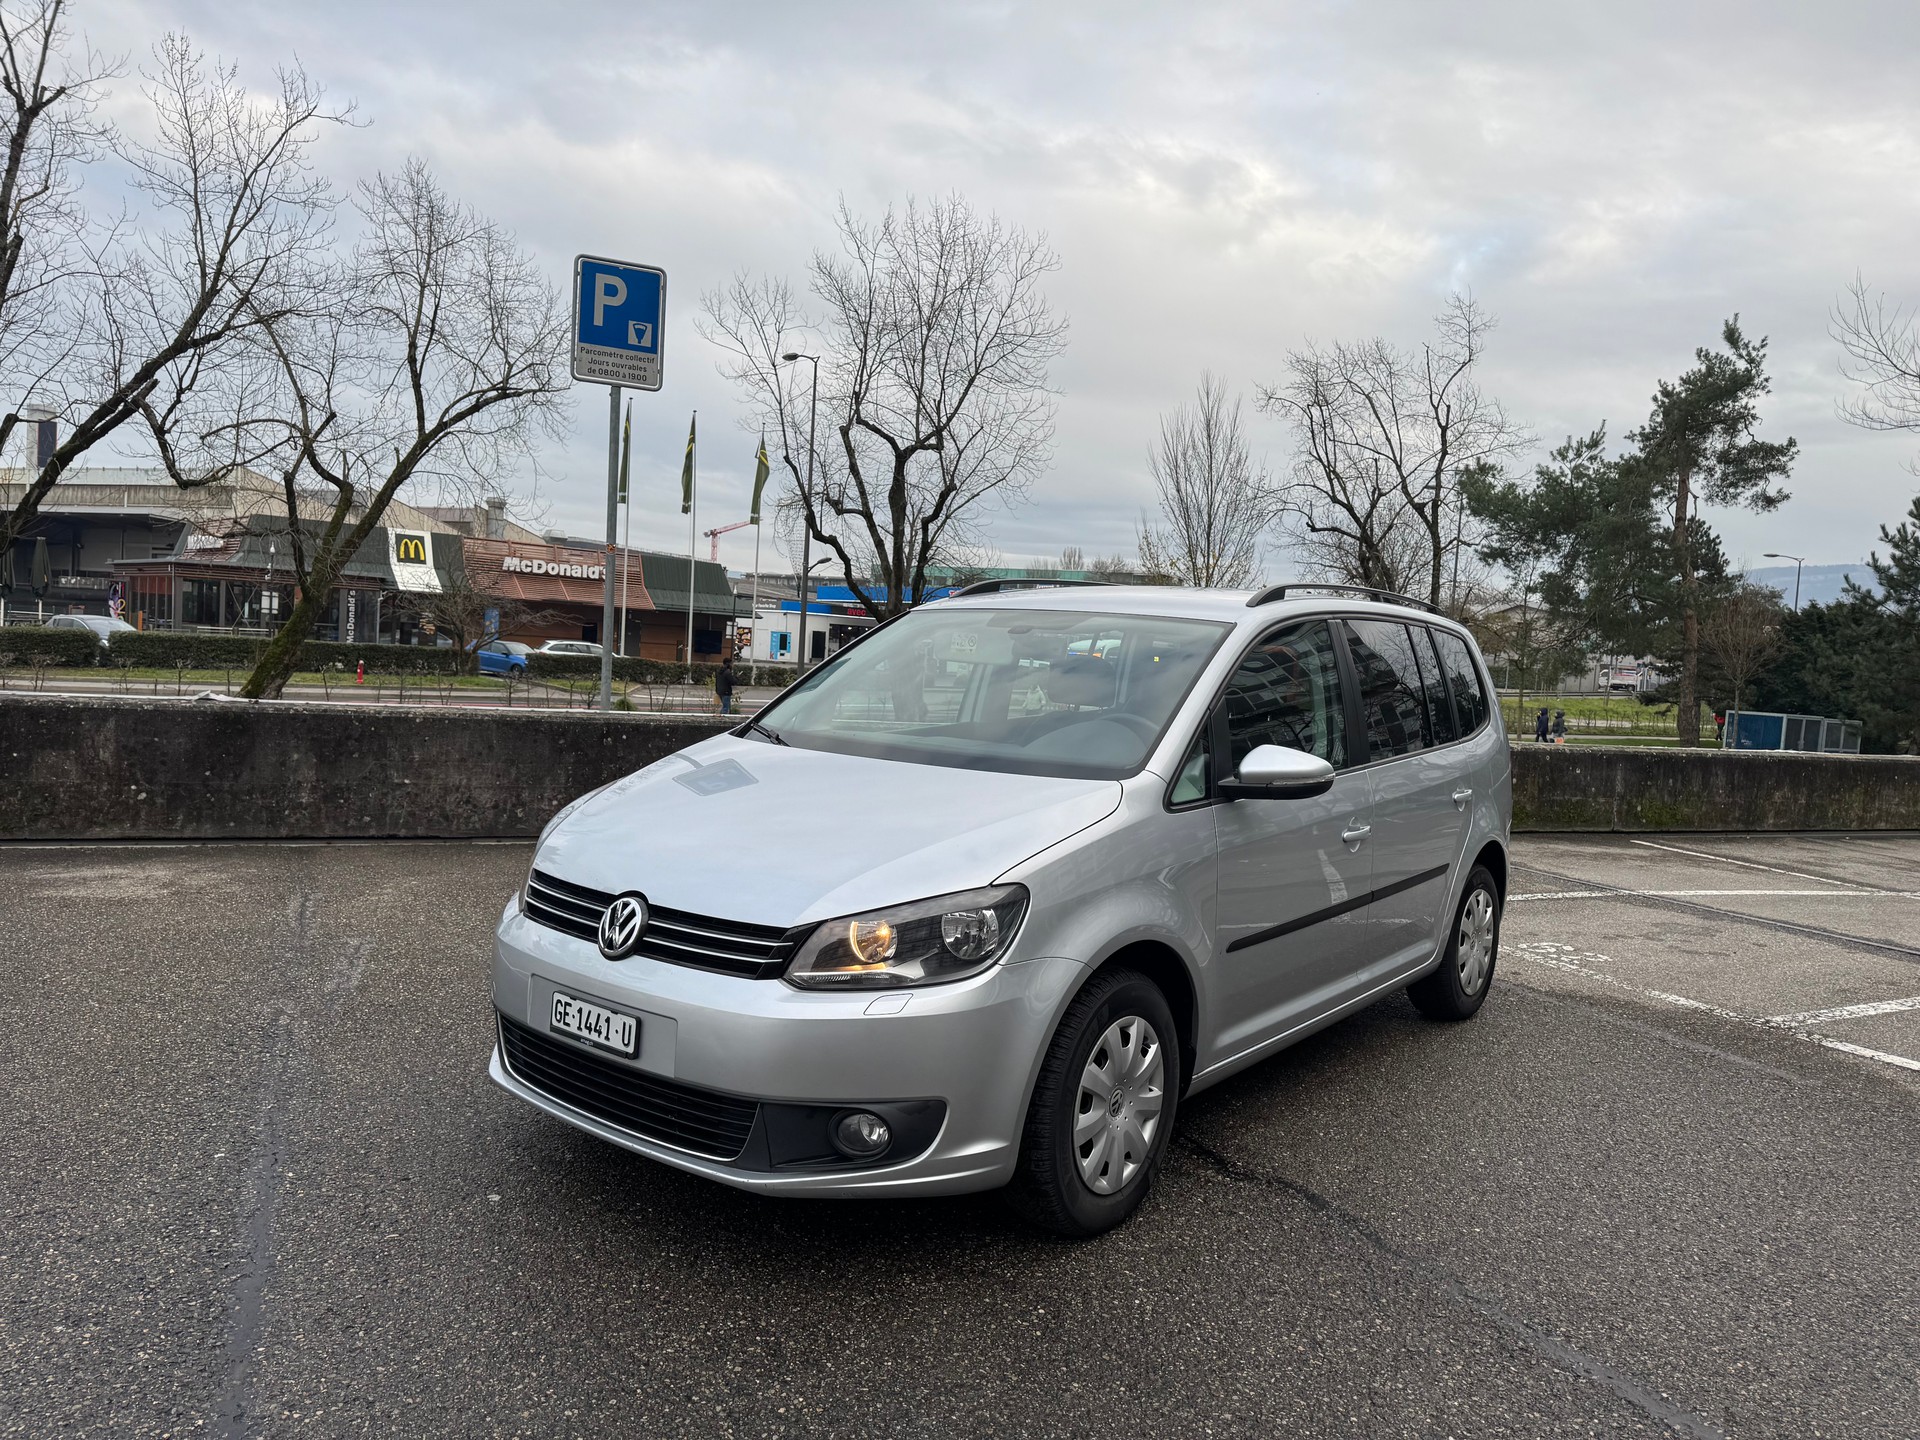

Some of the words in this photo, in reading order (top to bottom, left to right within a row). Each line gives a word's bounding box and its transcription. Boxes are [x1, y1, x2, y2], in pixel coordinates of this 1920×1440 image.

[593, 273, 628, 327] P
[580, 346, 624, 360] Parcomètre
[625, 354, 655, 365] collectif
[587, 366, 597, 375] de
[588, 357, 610, 367] Jours
[611, 363, 648, 373] ouvrables
[346, 590, 356, 644] McDonald's
[847, 608, 867, 616] avec
